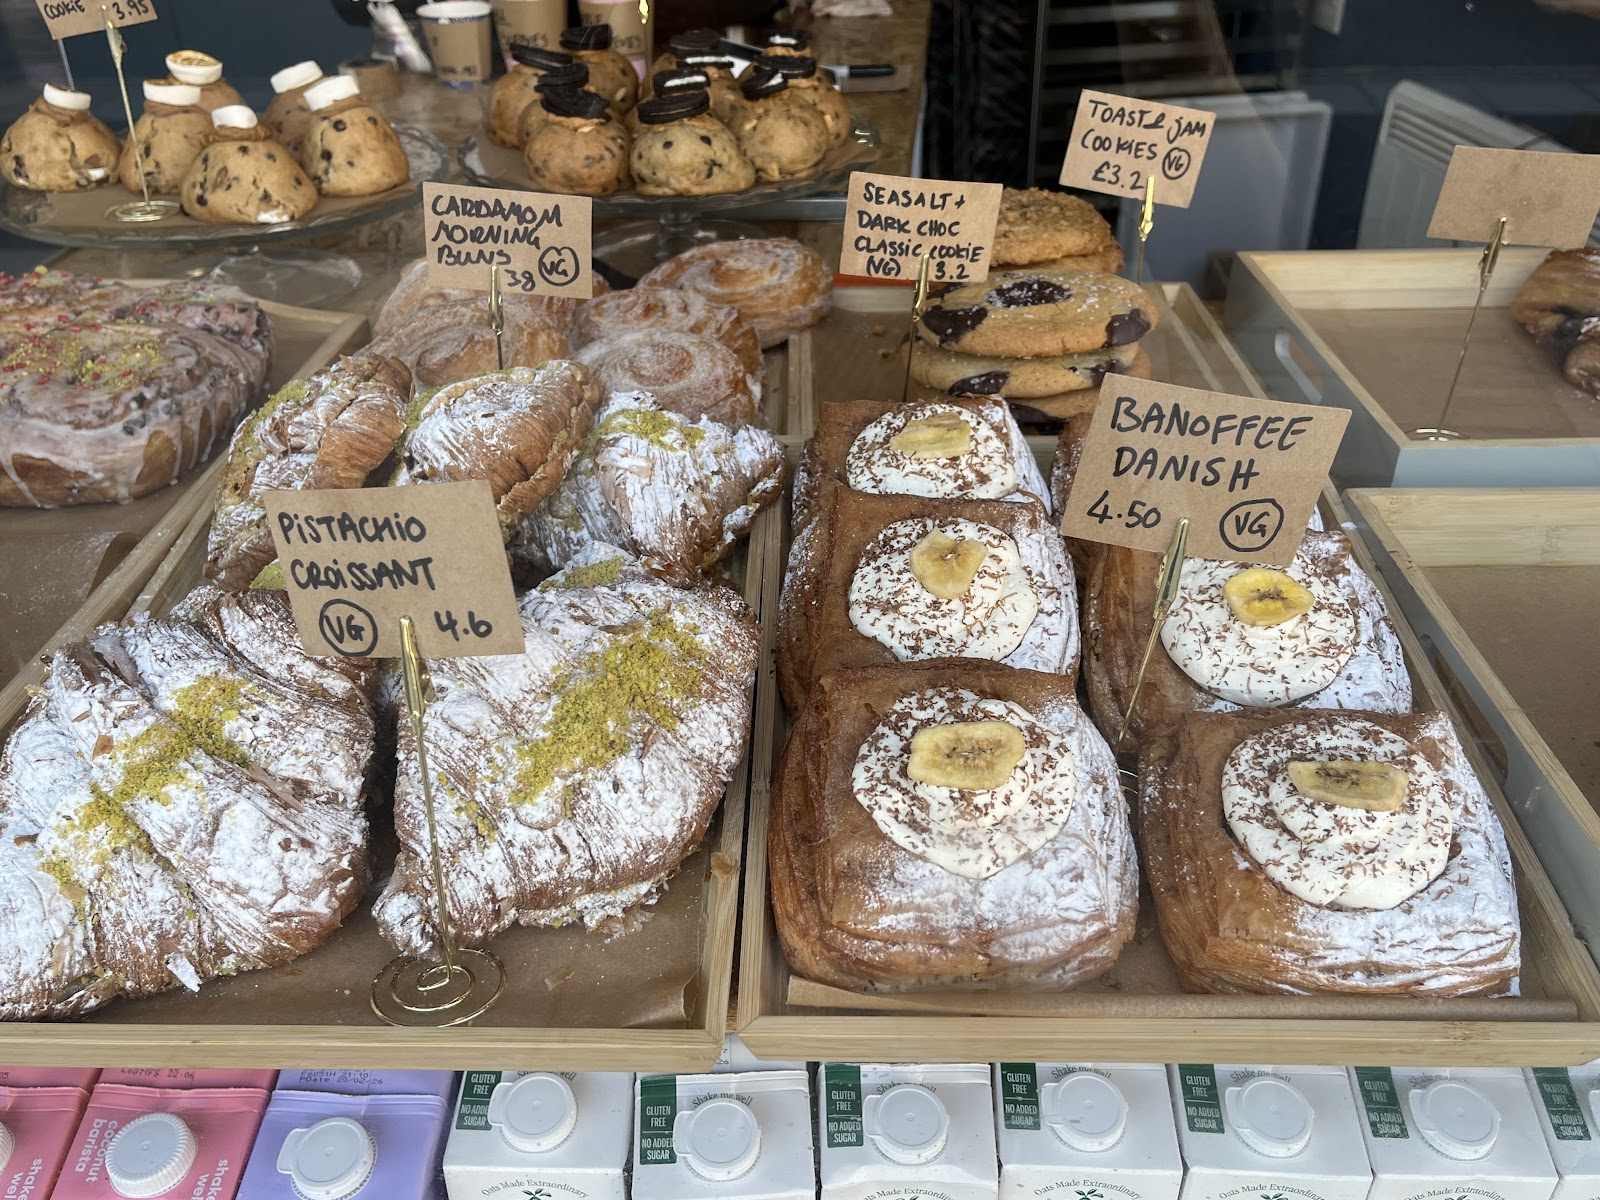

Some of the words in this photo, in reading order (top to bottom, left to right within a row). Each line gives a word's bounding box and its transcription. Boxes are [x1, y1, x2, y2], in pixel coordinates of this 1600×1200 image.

[112, 0, 149, 20] 3.95
[1089, 100, 1151, 127] TOAST
[1081, 129, 1157, 160] COOKIES
[1167, 152, 1184, 172] VG
[1092, 161, 1144, 190] £3.2
[864, 182, 952, 211] SEASALT
[955, 194, 966, 210] +
[432, 195, 562, 227] CARDAMOM
[857, 210, 911, 234] DARK
[917, 220, 960, 237] CHOC
[437, 244, 511, 266] BUNS
[541, 258, 569, 278] VG
[935, 260, 970, 280] 3.2
[1111, 396, 1313, 450] BANOFFEE
[1113, 446, 1259, 492] DANISH
[1087, 490, 1161, 528] 4.50
[1234, 511, 1270, 538] VG
[323, 614, 365, 644] VG
[434, 611, 493, 642] 4.6
[471, 1073, 496, 1084] GLUTEN
[1007, 1072, 1031, 1084] GLUTEN
[1051, 1064, 1077, 1079] Shake
[1230, 1067, 1256, 1083] Shake
[1186, 1075, 1211, 1086] GLUTEN
[473, 1085, 489, 1095] FREE
[831, 1090, 856, 1100] GLUTEN
[1012, 1084, 1027, 1094] FREE
[1192, 1087, 1208, 1097] FREE
[692, 1092, 718, 1108] Shake
[836, 1101, 852, 1111] FREE
[461, 1104, 471, 1114] NO
[471, 1105, 489, 1115] ADDE
[646, 1106, 671, 1116] GLUTEN
[1005, 1104, 1014, 1113] NO
[1015, 1105, 1037, 1115] ADDED
[1187, 1106, 1197, 1116] NO
[1198, 1107, 1220, 1118] ADDED
[463, 1116, 487, 1126] SUGAR
[651, 1117, 667, 1127] FREE
[828, 1122, 838, 1132] NO
[839, 1122, 861, 1131] ADDED
[1011, 1115, 1033, 1126] SUGAR
[1194, 1118, 1217, 1129] SUGAR
[75, 1118, 107, 1172] barista
[642, 1138, 652, 1148] NO
[834, 1133, 857, 1143] SUGAR
[85, 1120, 118, 1182] coconut
[646, 1149, 670, 1160] SUGAR
[4, 1172, 24, 1200] wel
[190, 1173, 209, 1200] wel
[481, 1185, 501, 1196] Oats
[499, 1179, 526, 1190] Made
[527, 1179, 589, 1199] Extraordinary
[876, 1188, 902, 1198] Made
[1034, 1184, 1055, 1196] Oats
[1055, 1179, 1080, 1189] Made
[1083, 1179, 1143, 1200] Extraordinary
[1219, 1189, 1240, 1200] Oats
[1241, 1183, 1267, 1193] Made
[1427, 1187, 1453, 1197] Made
